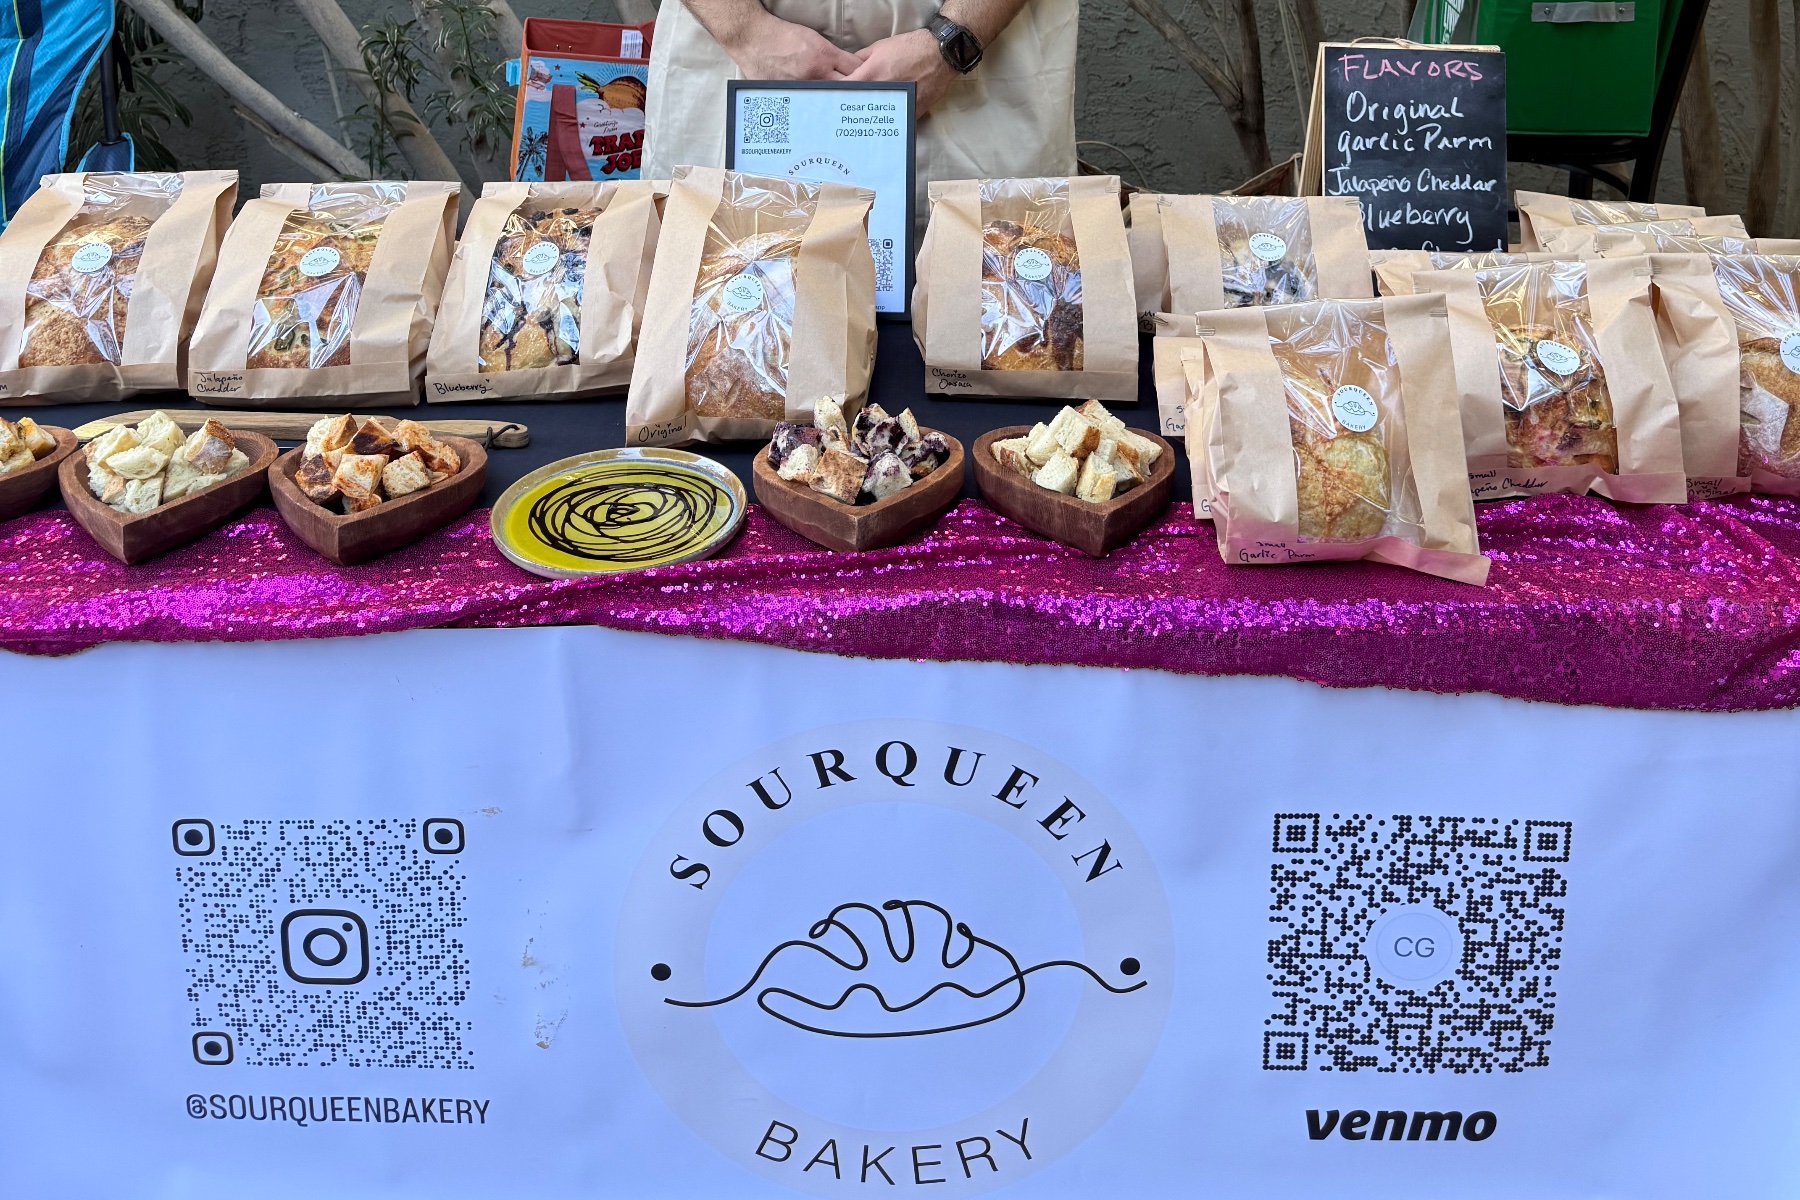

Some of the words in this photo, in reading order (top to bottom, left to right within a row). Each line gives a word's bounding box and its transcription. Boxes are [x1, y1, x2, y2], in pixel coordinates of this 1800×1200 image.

[1337, 53, 1484, 82] FLAVORS
[840, 103, 866, 112] Cesar
[867, 102, 896, 111] Garcia
[841, 115, 895, 125] Phone/Zelle
[1346, 90, 1465, 135] Original
[589, 128, 645, 156] TRAD
[835, 128, 900, 138] (702)910-7306
[600, 148, 643, 175] JOE
[788, 157, 851, 176] SOURQUEEN
[1416, 167, 1498, 193] Cheddar
[432, 382, 494, 395] Blueberry
[638, 414, 687, 443] Original
[1471, 482, 1498, 497] peño
[1239, 548, 1277, 563] Garlic
[669, 740, 1123, 890] SOURQUEEN
[1393, 936, 1436, 958] CG
[186, 1093, 491, 1127] @SOURQUEENBAKERY
[1305, 1109, 1498, 1141] venmo
[754, 1117, 1033, 1186] BAKERY
